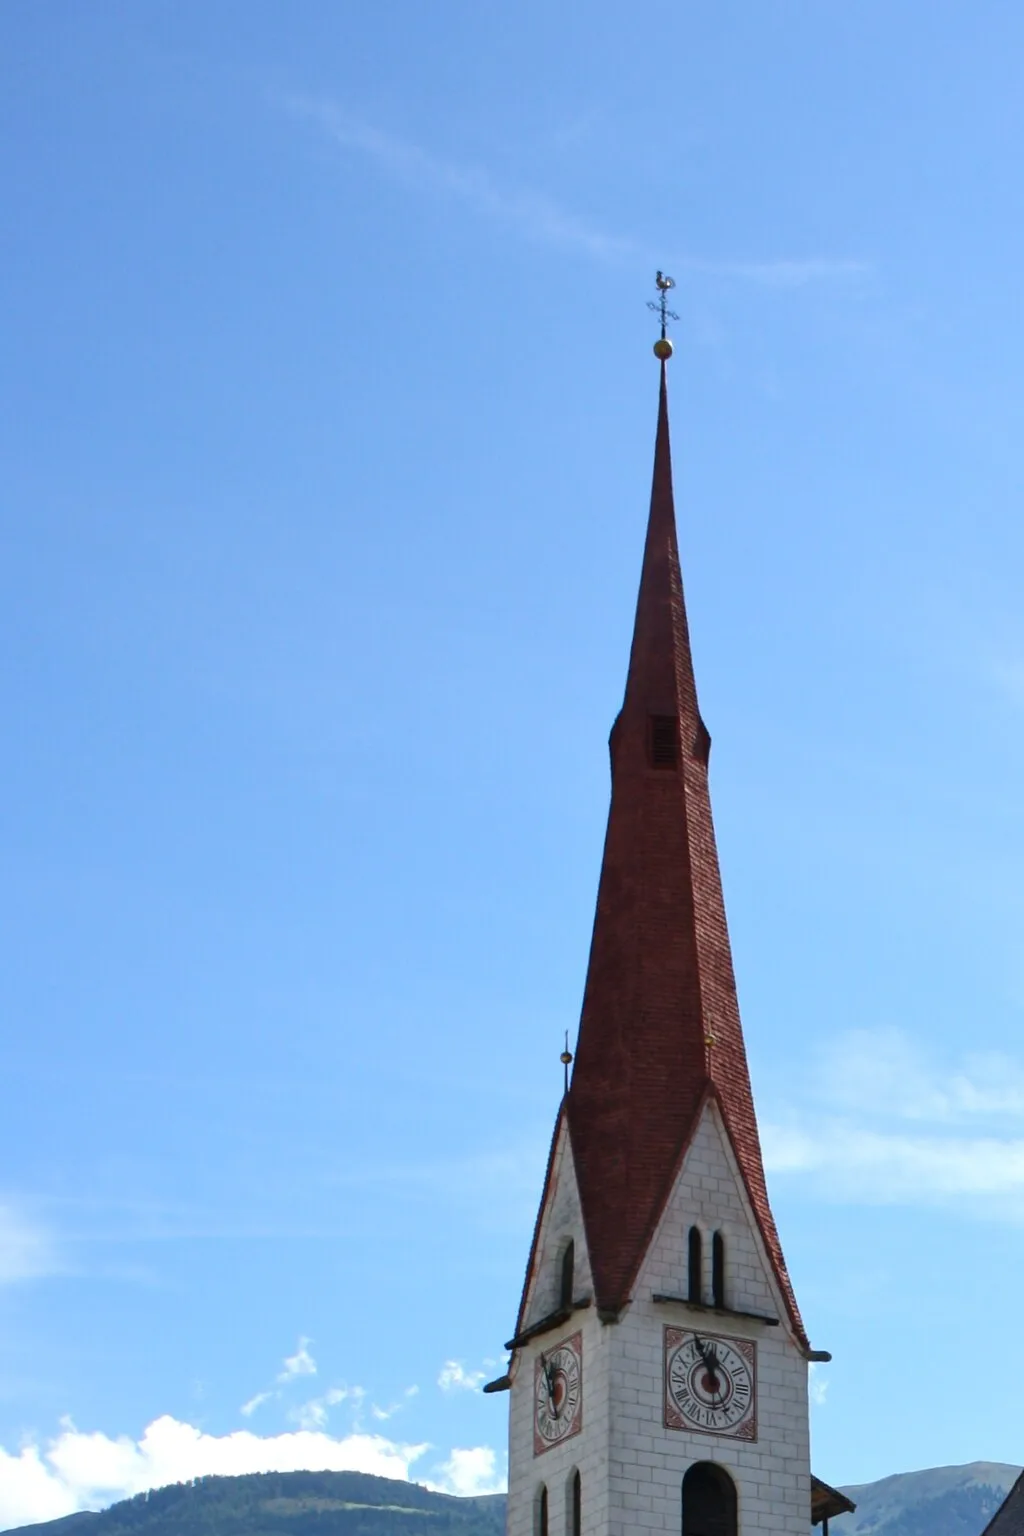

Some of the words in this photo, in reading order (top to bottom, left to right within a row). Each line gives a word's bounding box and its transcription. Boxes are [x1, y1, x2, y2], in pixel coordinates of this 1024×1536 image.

[731, 1366, 745, 1377] II
[735, 1383, 749, 1396] III
[687, 1402, 701, 1421] VII
[705, 1410, 717, 1426] VI
